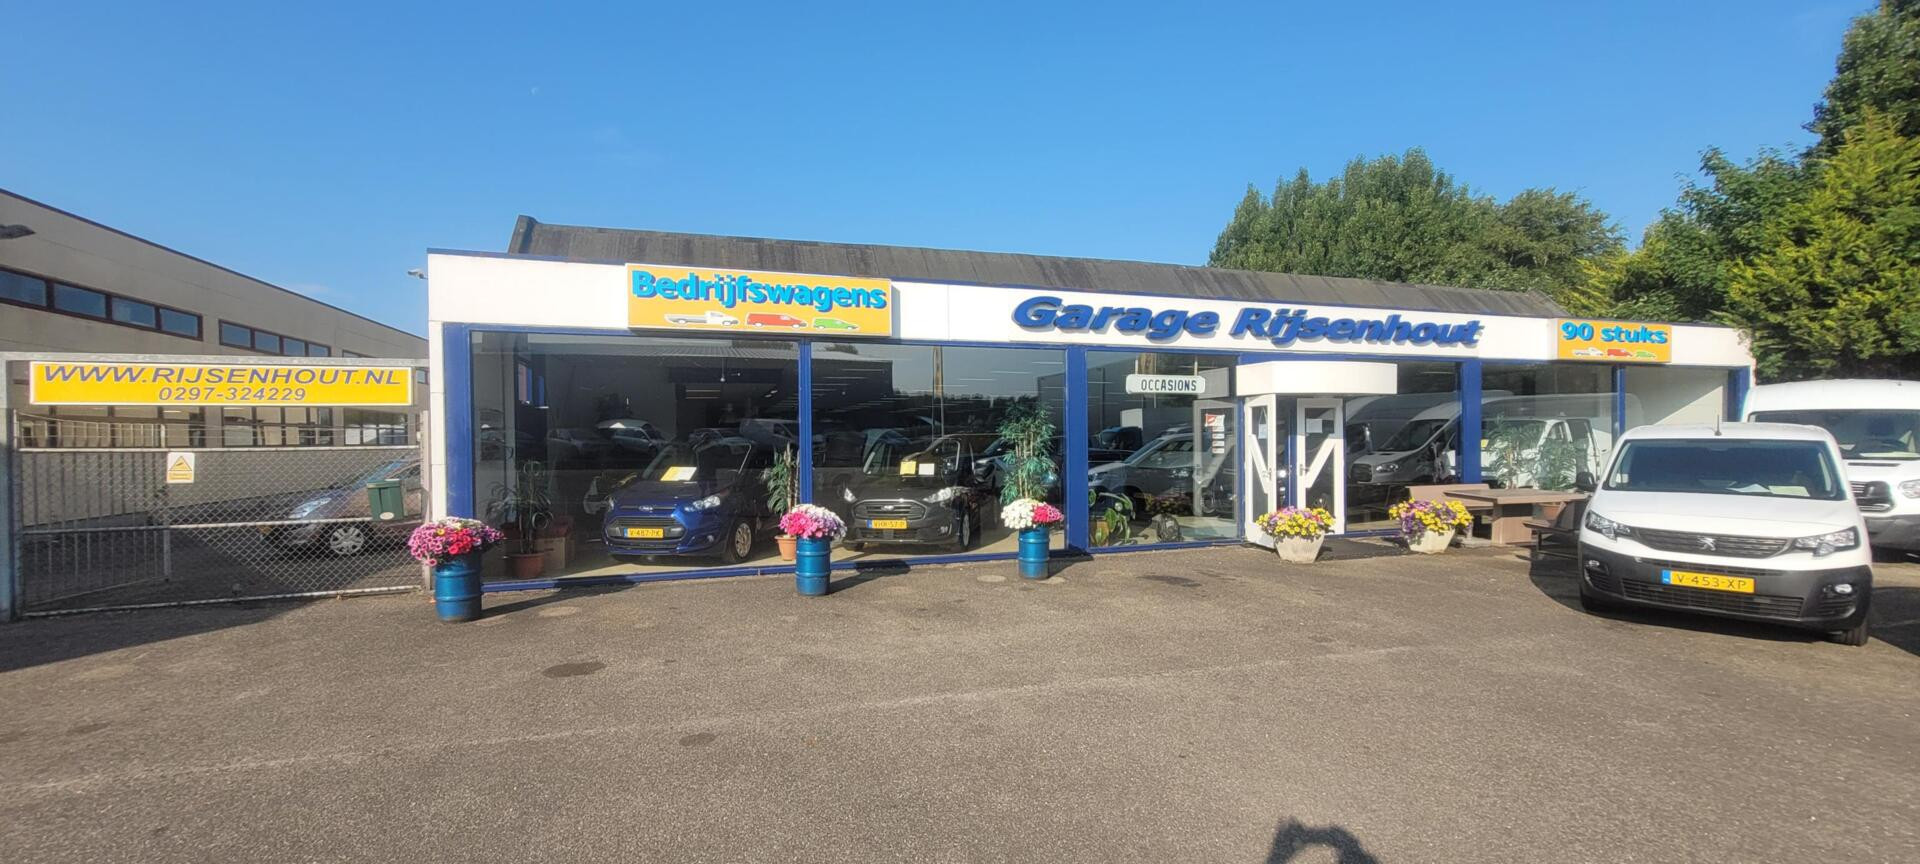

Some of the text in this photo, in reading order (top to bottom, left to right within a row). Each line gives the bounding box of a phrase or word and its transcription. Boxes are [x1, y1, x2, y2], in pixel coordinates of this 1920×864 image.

[631, 270, 887, 312] Bedrijfswagens
[1012, 295, 1484, 348] Garage Rijsenhout
[1561, 321, 1668, 344] 90 stuks
[44, 365, 401, 385] WWW.RIJSENHOUT.NL
[1141, 379, 1197, 391] OCCASIONS
[158, 386, 307, 401] 0297-324229
[1676, 574, 1747, 590] V-453-XP
